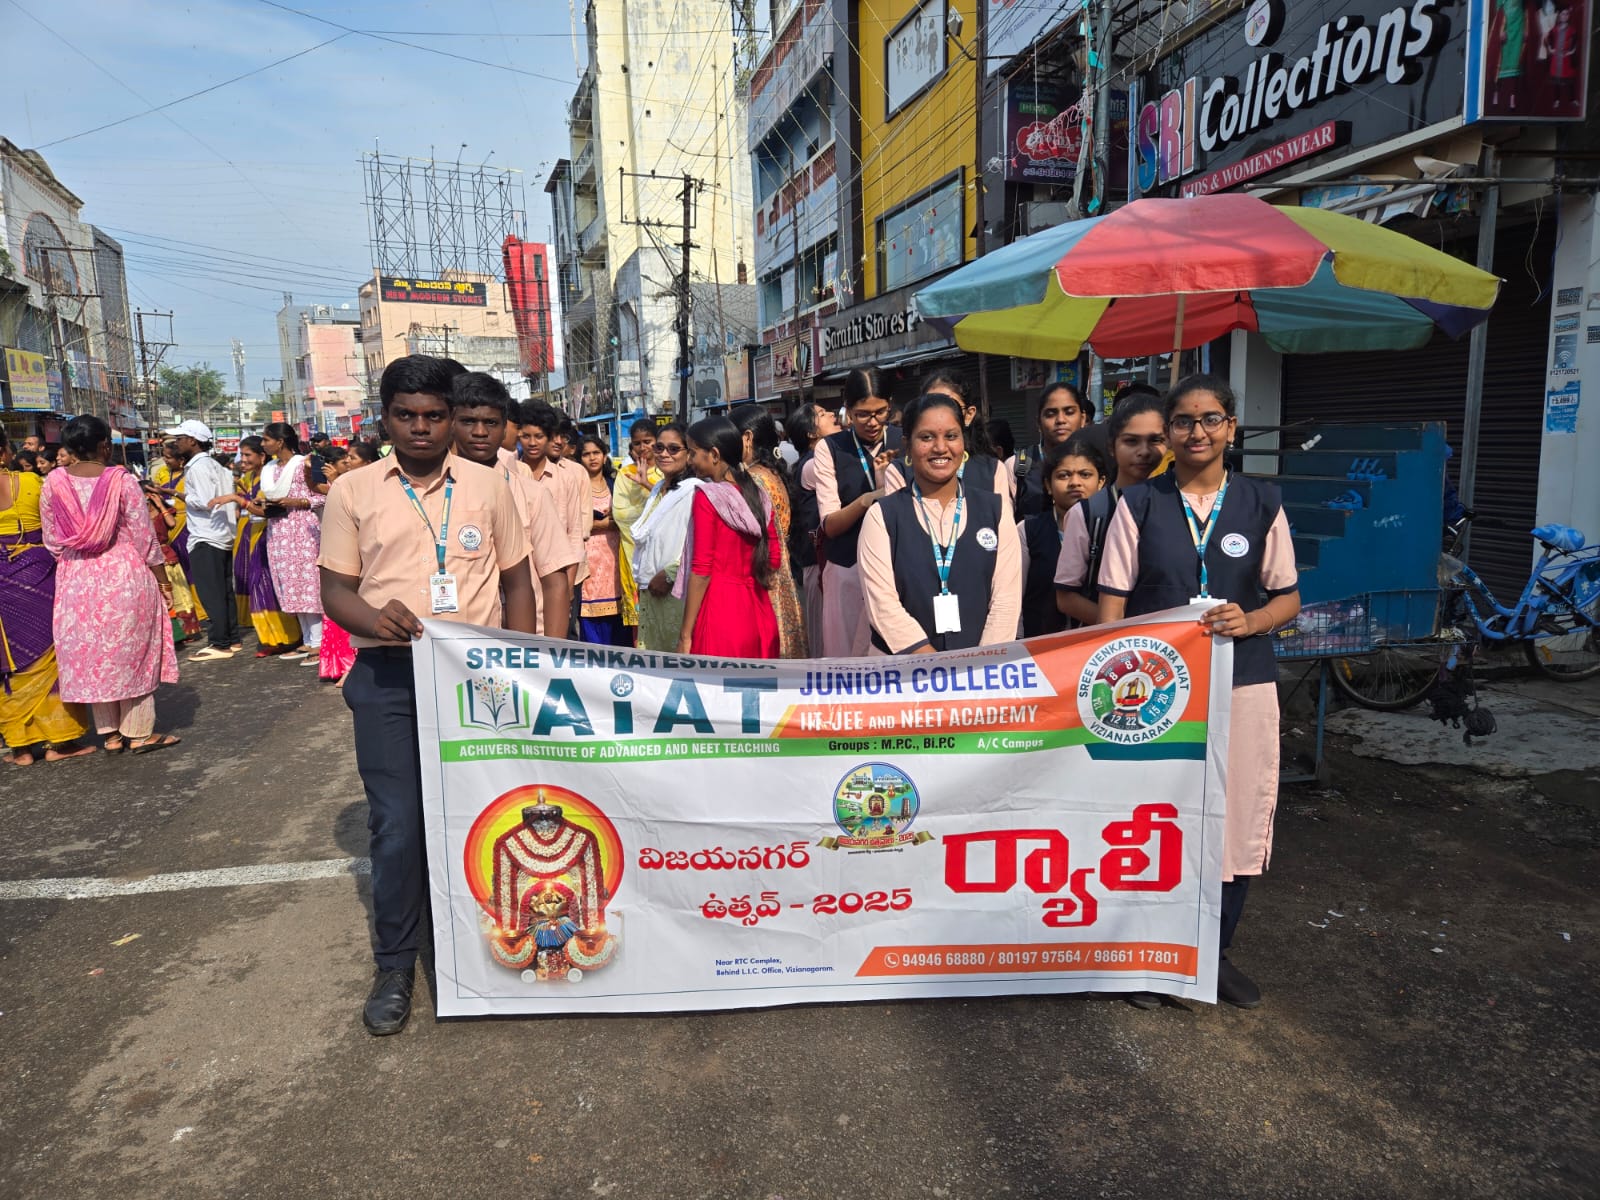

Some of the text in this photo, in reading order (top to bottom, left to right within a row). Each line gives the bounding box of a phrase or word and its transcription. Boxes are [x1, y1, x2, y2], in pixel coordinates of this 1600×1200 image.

[1137, 0, 1433, 193] SRI Collections
[1183, 126, 1332, 196] KIDS & WOMEN'S WEAR
[385, 290, 483, 304] NEW MODERN STORES
[824, 311, 905, 351] Sarathi Stores
[466, 647, 540, 670] SREE
[1124, 660, 1133, 670] 8
[1079, 668, 1095, 698] SREE
[1089, 638, 1180, 668] VENKATESWARA
[1174, 664, 1190, 691] AIAT
[1109, 671, 1118, 681] 8
[1153, 670, 1165, 682] 18
[800, 663, 1038, 696] JUNIOR COLLEGE
[1158, 693, 1169, 704] 20
[868, 715, 895, 729] AND
[900, 708, 944, 729] NEET
[948, 704, 1039, 727] ACADEMY
[1111, 714, 1122, 724] 12
[1148, 706, 1161, 717] 15
[1126, 716, 1137, 726] 22
[1090, 718, 1174, 743] VIZIANAGARAM
[459, 742, 780, 758] ACHIVERS INSTITUTE OF ADVANCED AND NEET TEACHING
[829, 740, 869, 752] Groups
[977, 737, 1044, 750] A/C Campus
[638, 841, 810, 870] విజయనగర్
[942, 803, 1183, 927] ర్యాలీ
[698, 891, 781, 926] ఉత్సవ్
[812, 888, 913, 914] 2025
[750, 957, 782, 965] Complex,
[902, 950, 1179, 967] 94946 68880 / 80197 97564 / 98661 17801
[716, 968, 740, 976] Behind
[761, 966, 784, 975] Office,
